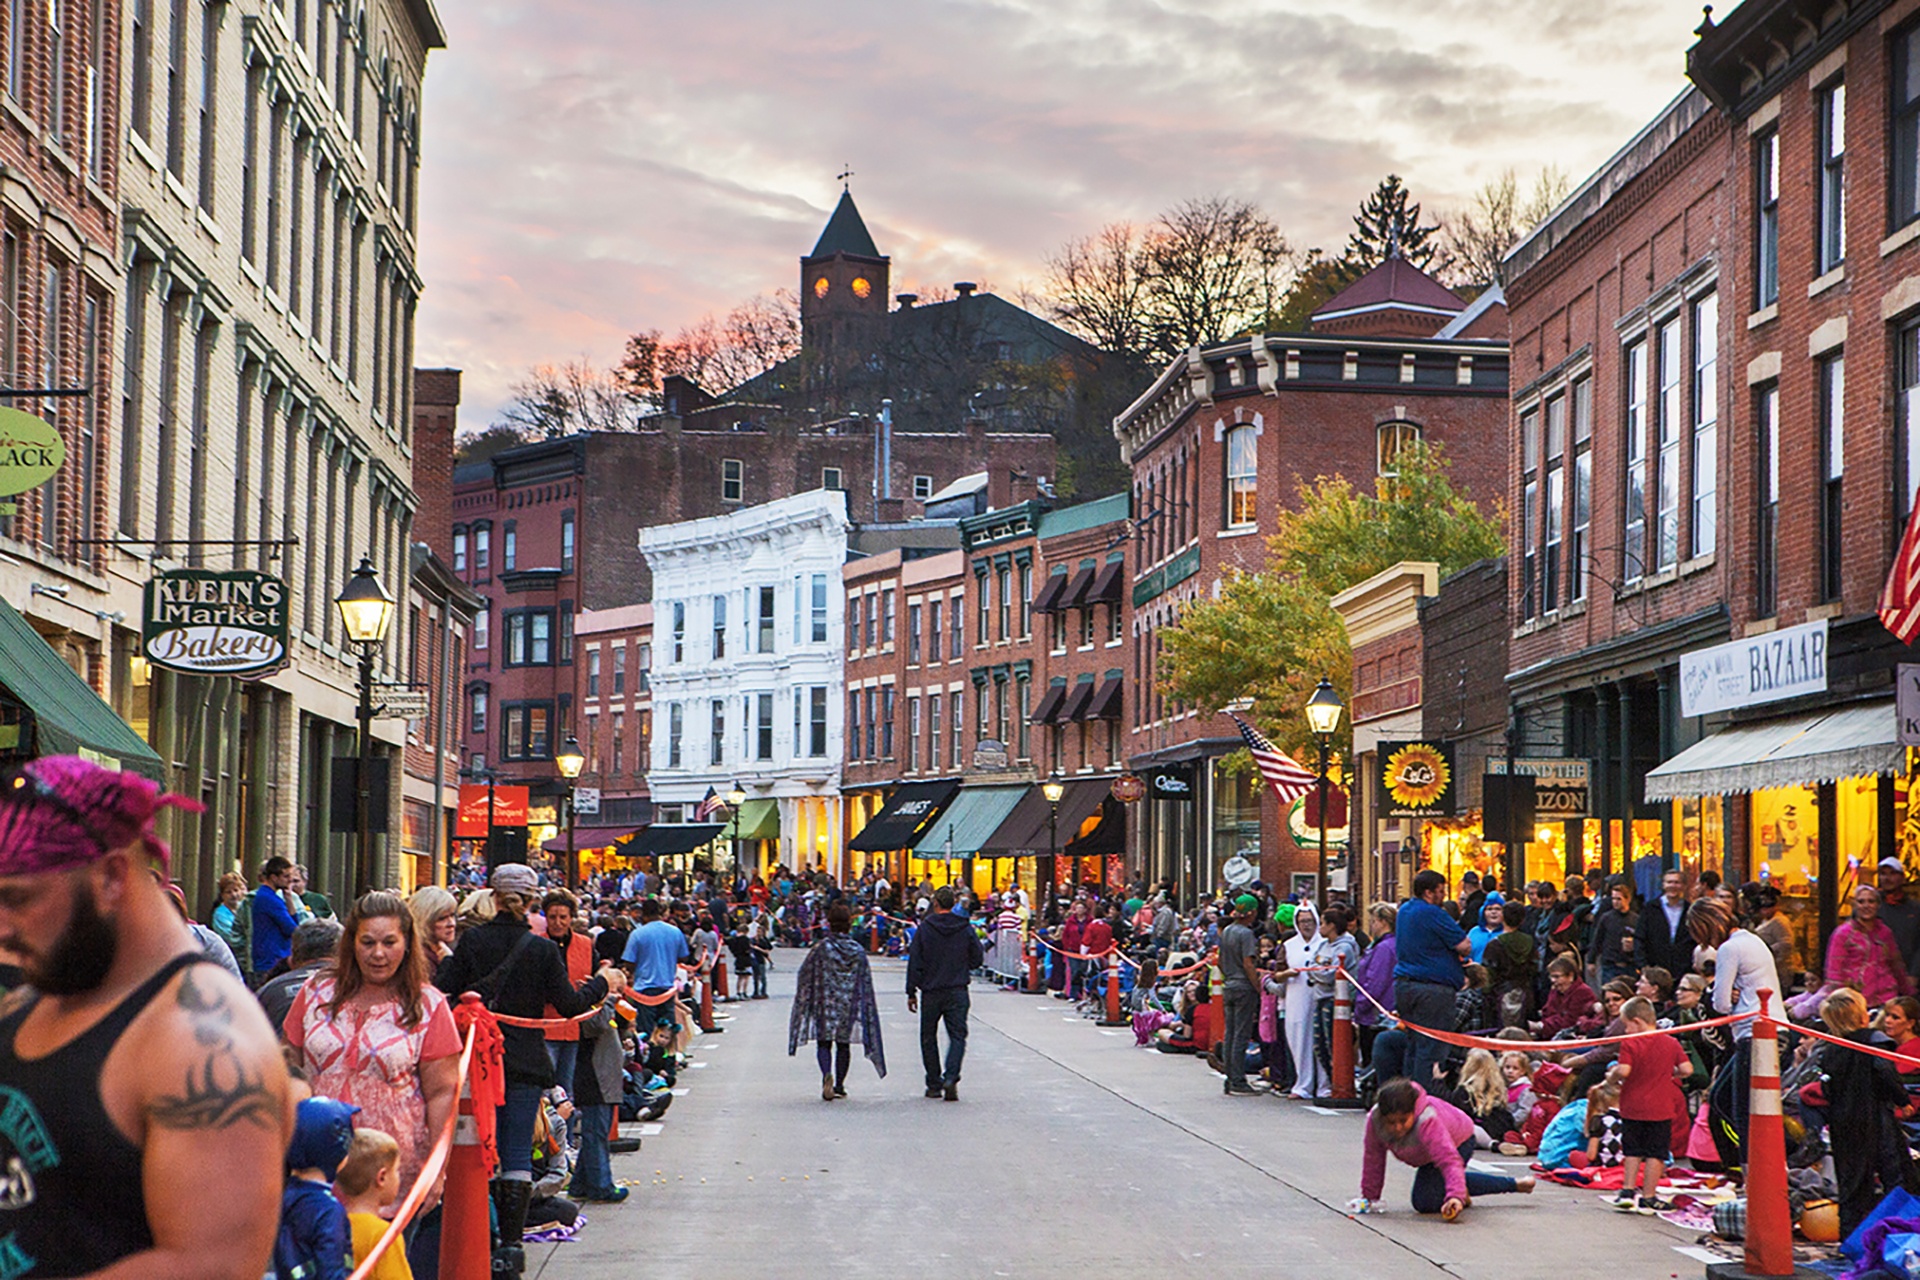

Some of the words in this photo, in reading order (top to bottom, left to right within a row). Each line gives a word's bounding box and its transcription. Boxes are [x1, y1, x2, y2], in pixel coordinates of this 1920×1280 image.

[0, 448, 55, 467] ACK
[151, 575, 282, 622] KLEIN'S
[165, 604, 281, 627] Market
[154, 626, 279, 661] Bakery
[1748, 630, 1825, 693] BAZAAR
[1556, 764, 1586, 779] THE
[493, 809, 524, 818] Elegant
